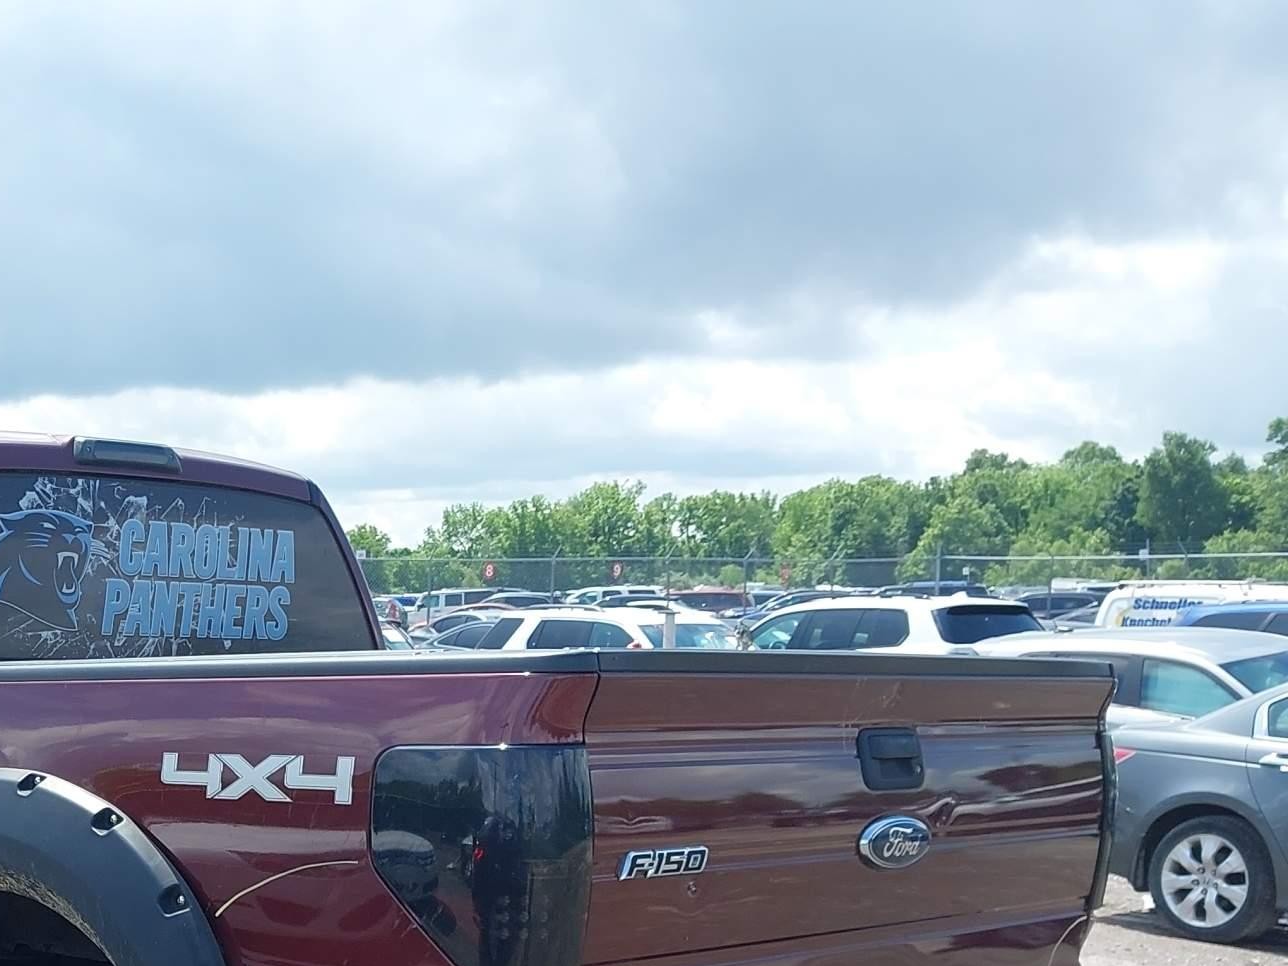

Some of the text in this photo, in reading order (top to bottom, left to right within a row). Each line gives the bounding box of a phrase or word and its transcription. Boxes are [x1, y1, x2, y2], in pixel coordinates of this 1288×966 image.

[119, 518, 295, 584] CAROLINA
[484, 564, 495, 577] 8
[101, 578, 291, 641] PANTHERS
[882, 827, 921, 858] Ford
